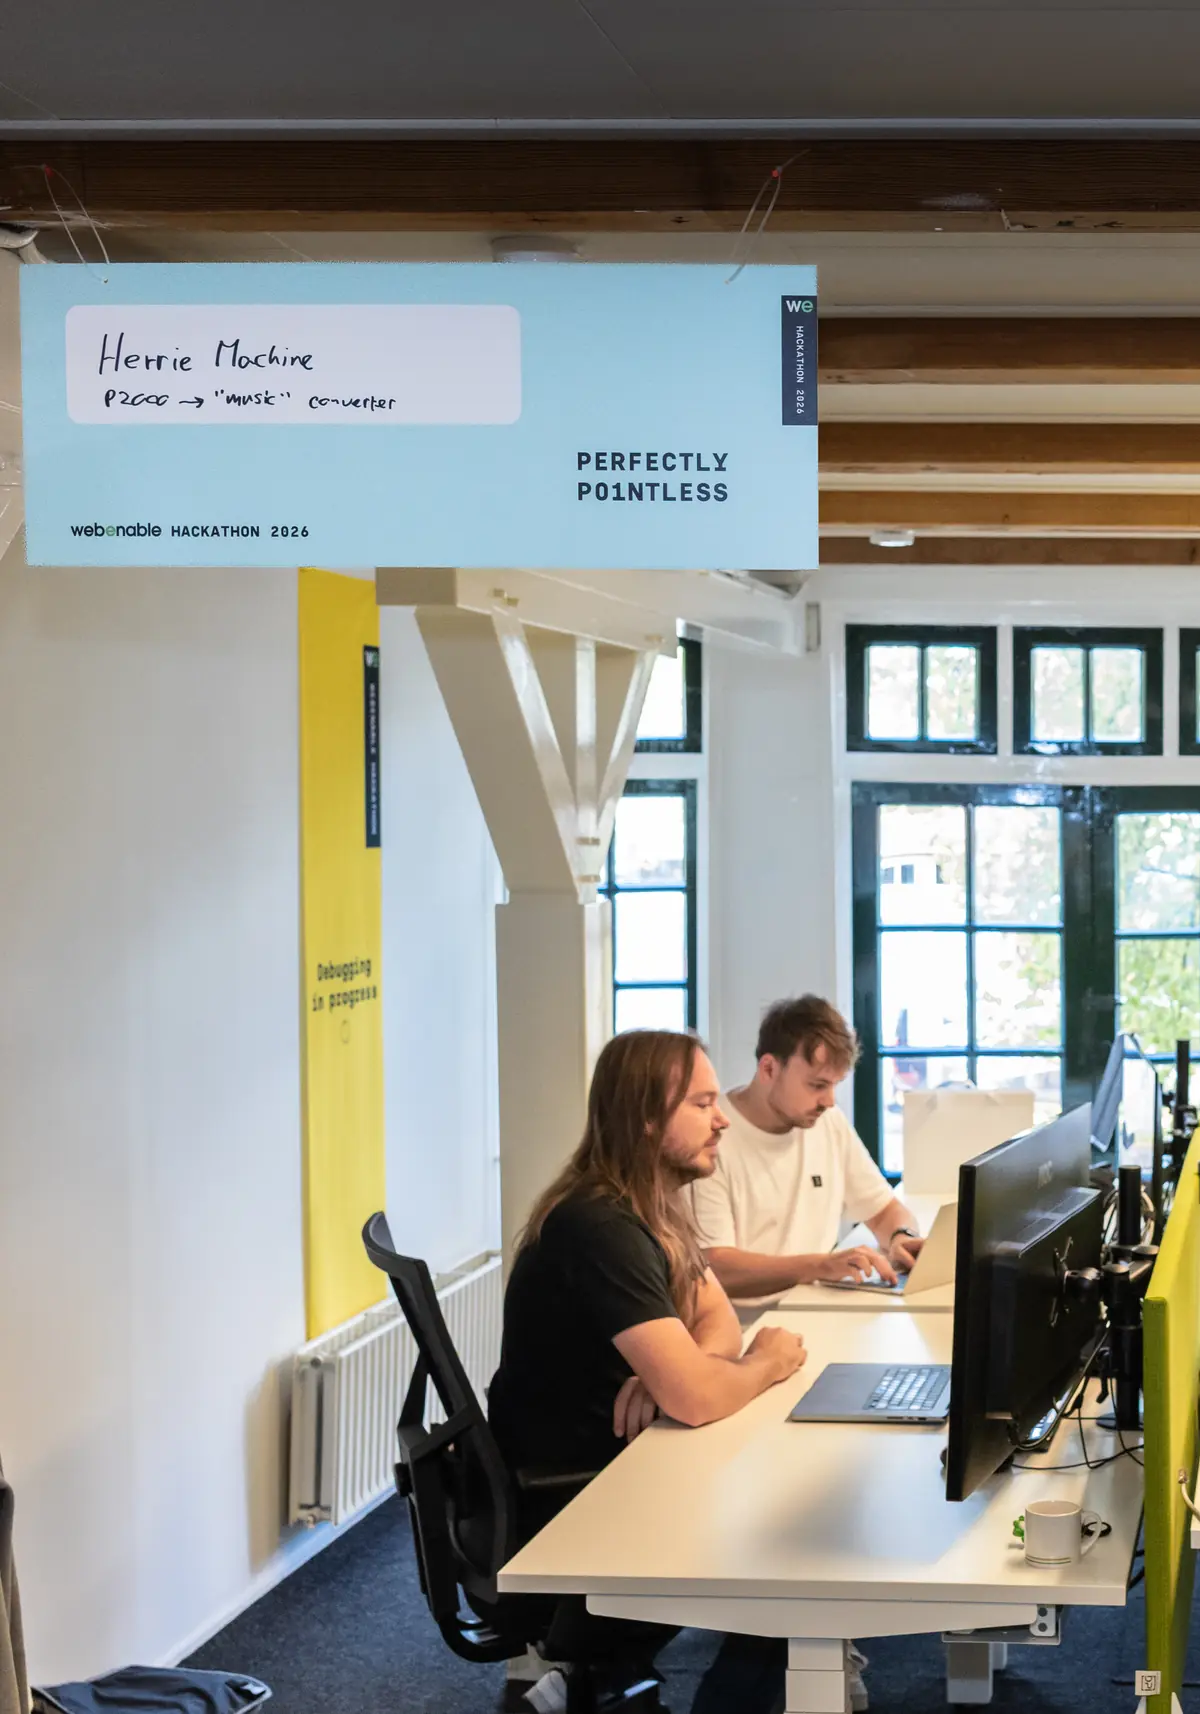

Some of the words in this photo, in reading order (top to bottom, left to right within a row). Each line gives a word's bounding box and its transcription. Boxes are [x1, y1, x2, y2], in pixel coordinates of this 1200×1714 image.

[785, 300, 814, 313] we
[98, 332, 193, 375] Herrie
[215, 338, 314, 370] Machine
[796, 325, 804, 383] HACKATHON
[308, 396, 397, 412] converter
[796, 389, 805, 414] 2026
[577, 451, 729, 472] PERFECTLY
[70, 522, 162, 537] webenable
[171, 525, 260, 538] HACKATHON
[270, 525, 309, 538] 2026
[317, 956, 371, 983] Debugging
[312, 990, 324, 1012] in
[329, 985, 377, 1014] progress
